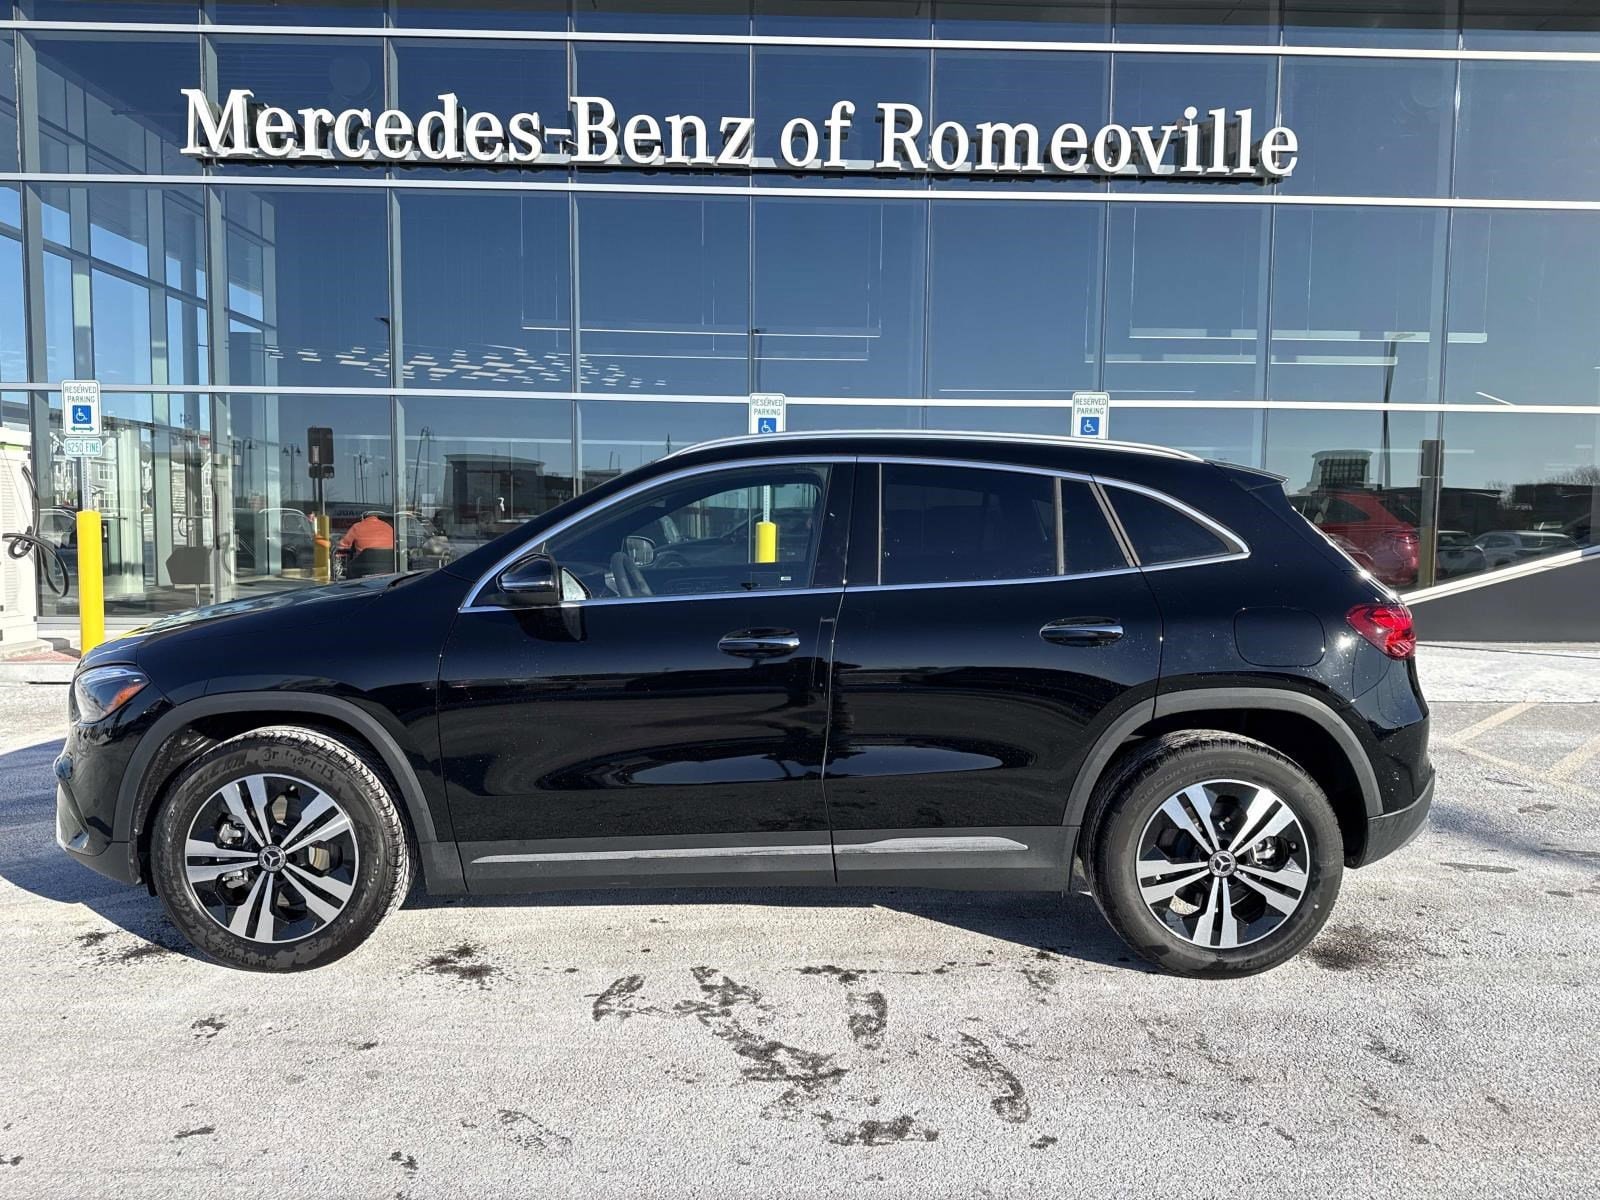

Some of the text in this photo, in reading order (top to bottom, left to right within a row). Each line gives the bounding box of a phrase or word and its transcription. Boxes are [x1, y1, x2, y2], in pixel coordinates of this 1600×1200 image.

[180, 88, 1299, 176] Mercedes-Benz of Romeoville
[64, 386, 97, 394] RESERVED
[751, 399, 783, 407] RESERVED
[1075, 398, 1107, 406] RESERVED
[753, 408, 781, 416] PARKING
[1076, 407, 1105, 415] PARKING
[66, 442, 100, 452] $250 FINE
